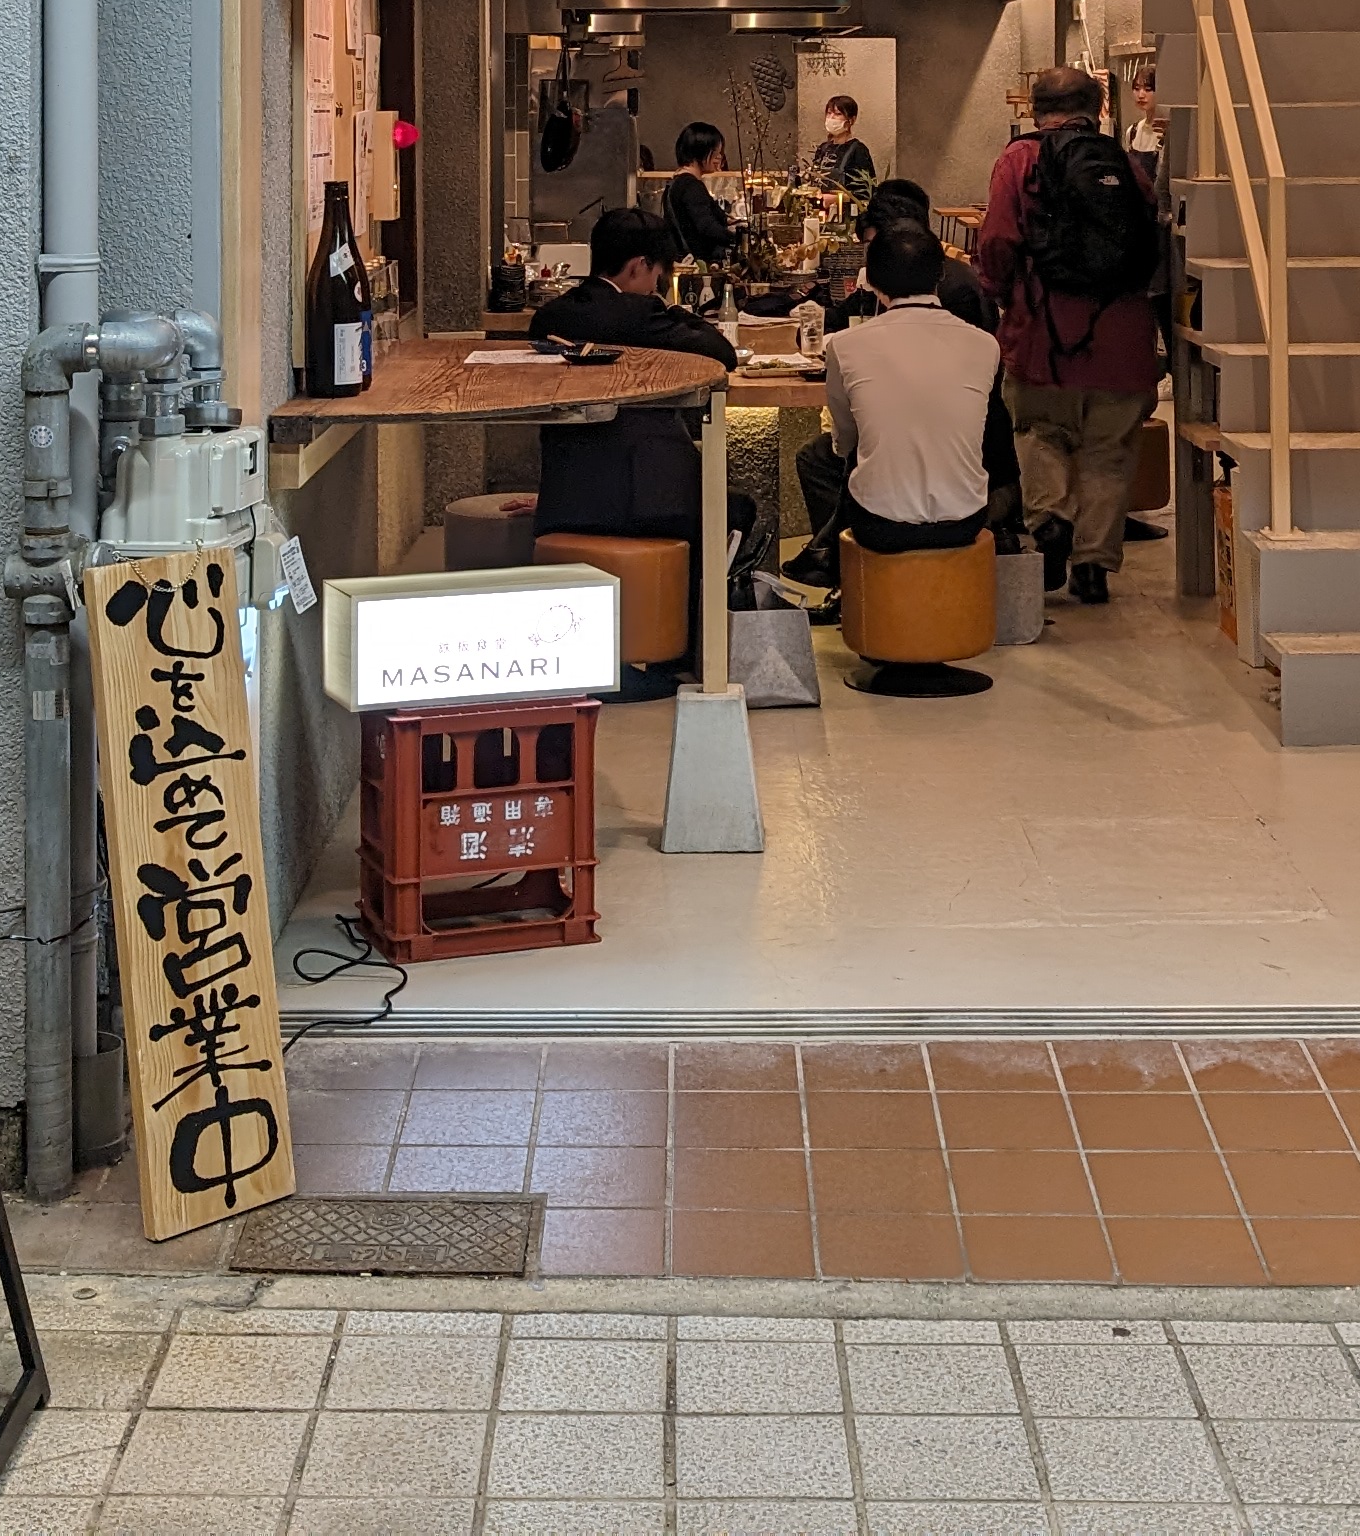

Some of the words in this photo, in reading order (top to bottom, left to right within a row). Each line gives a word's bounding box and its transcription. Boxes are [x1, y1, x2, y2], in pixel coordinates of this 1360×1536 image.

[381, 656, 561, 688] MASANARI
[104, 562, 279, 1210] 心を込めて営業中
